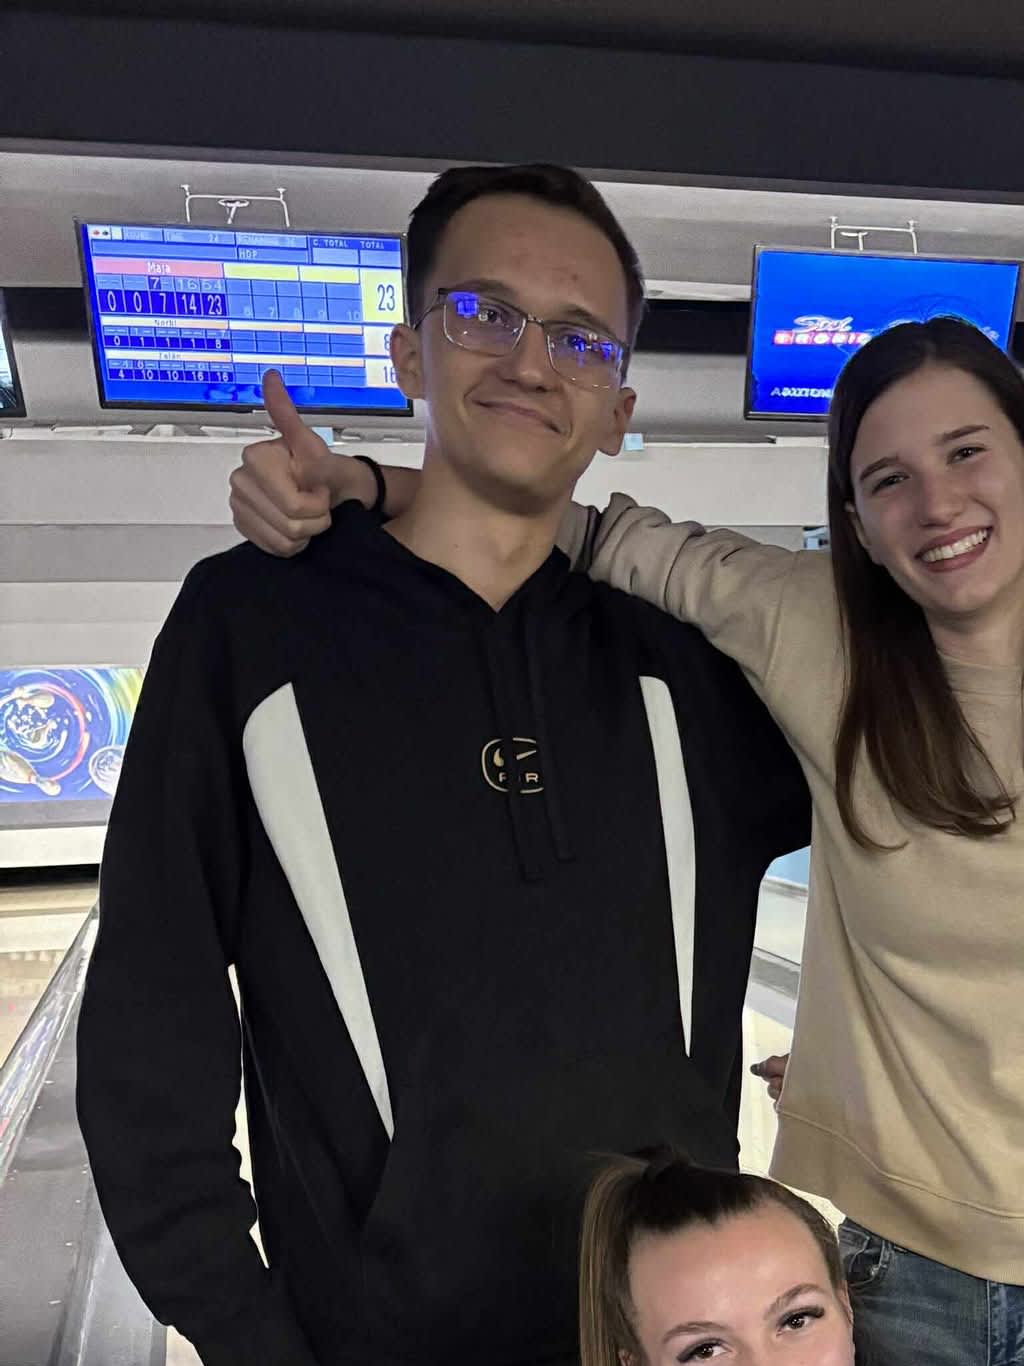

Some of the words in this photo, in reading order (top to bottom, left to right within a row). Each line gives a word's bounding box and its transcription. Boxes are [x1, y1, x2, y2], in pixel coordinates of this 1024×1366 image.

[324, 239, 349, 248] TOTAL
[360, 241, 385, 250] TOTAL
[107, 290, 116, 312] 0
[133, 291, 142, 313] 0
[159, 293, 167, 313] 7
[181, 294, 197, 314] 14
[207, 294, 223, 315] 23
[377, 283, 396, 311] 23
